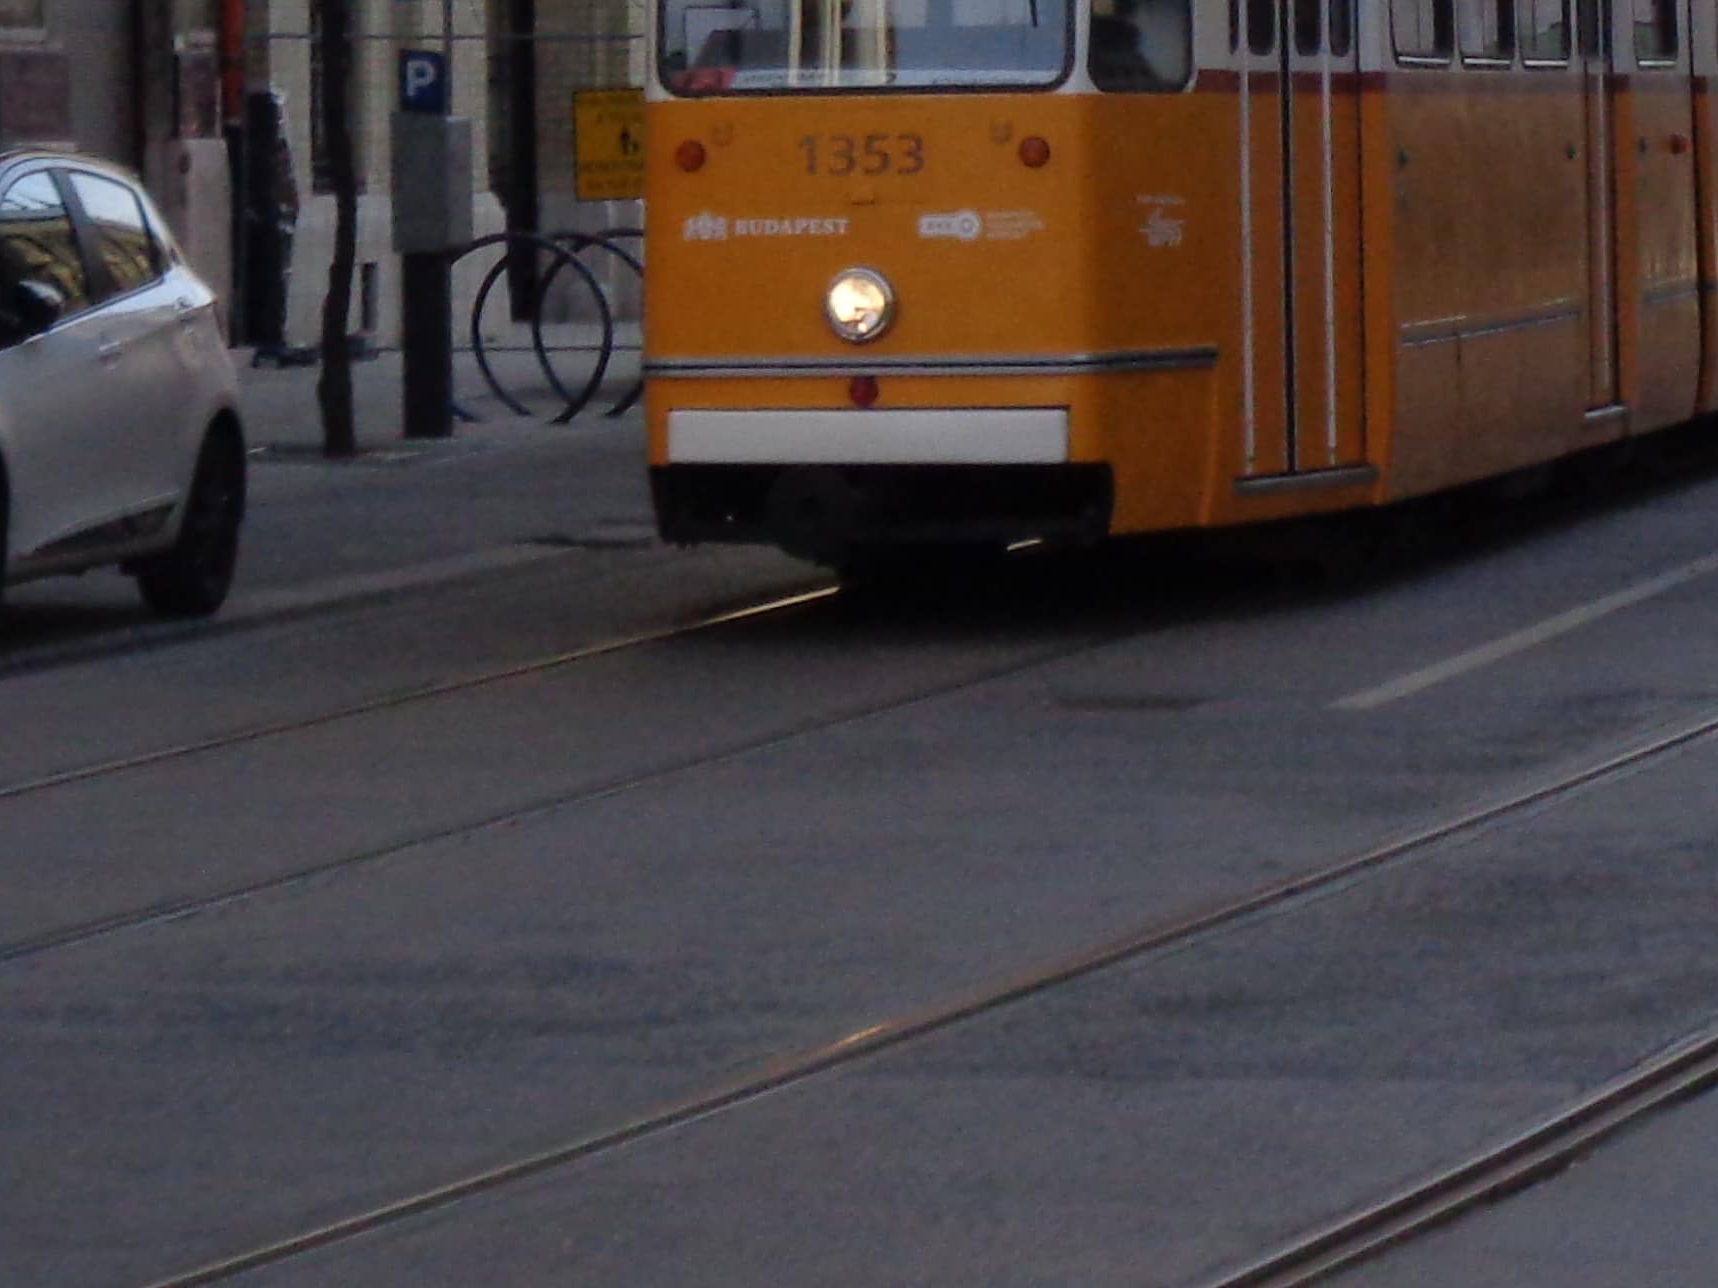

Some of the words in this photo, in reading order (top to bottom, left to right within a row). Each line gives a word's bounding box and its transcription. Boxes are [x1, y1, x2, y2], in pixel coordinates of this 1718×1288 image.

[405, 57, 435, 98] P
[798, 133, 926, 176] 1353
[734, 218, 850, 237] BUDAPEST
